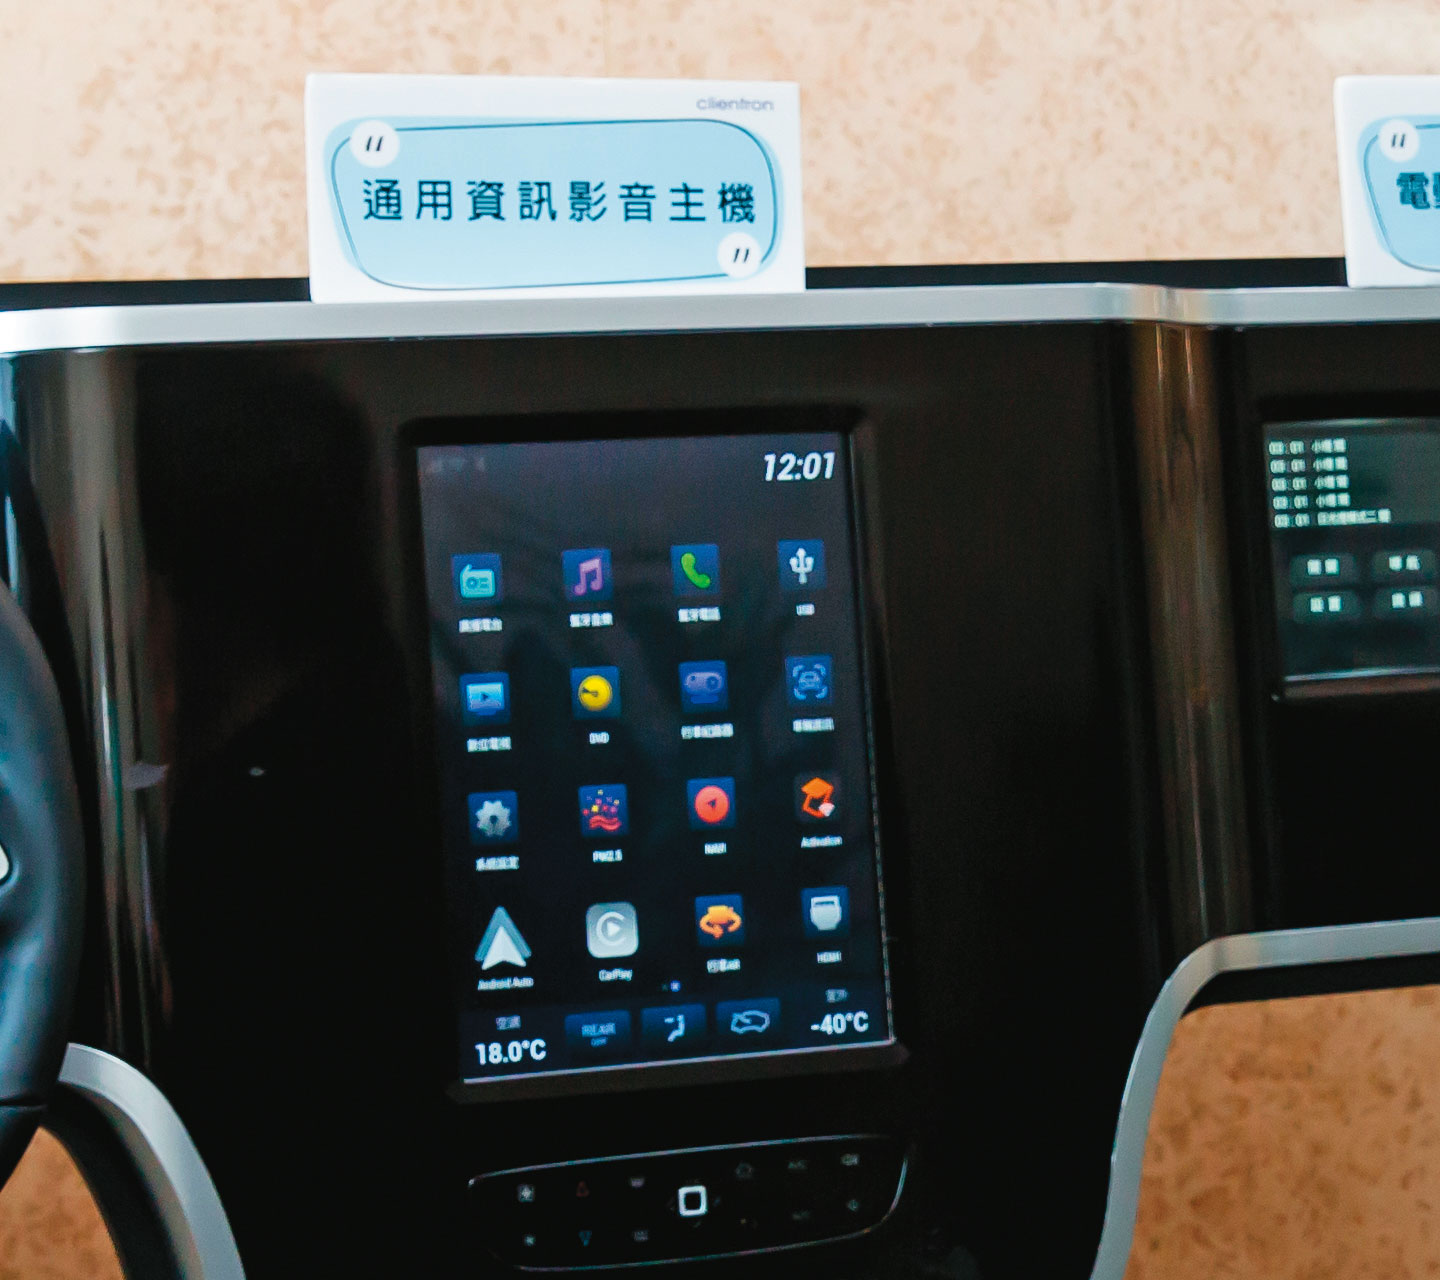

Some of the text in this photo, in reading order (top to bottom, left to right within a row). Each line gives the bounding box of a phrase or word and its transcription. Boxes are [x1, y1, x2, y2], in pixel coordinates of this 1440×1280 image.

[362, 178, 756, 224] 通用資訊影音主機
[763, 450, 836, 482] 12:01
[810, 1010, 869, 1036] -40°C
[475, 1038, 547, 1066] 18.0°C
